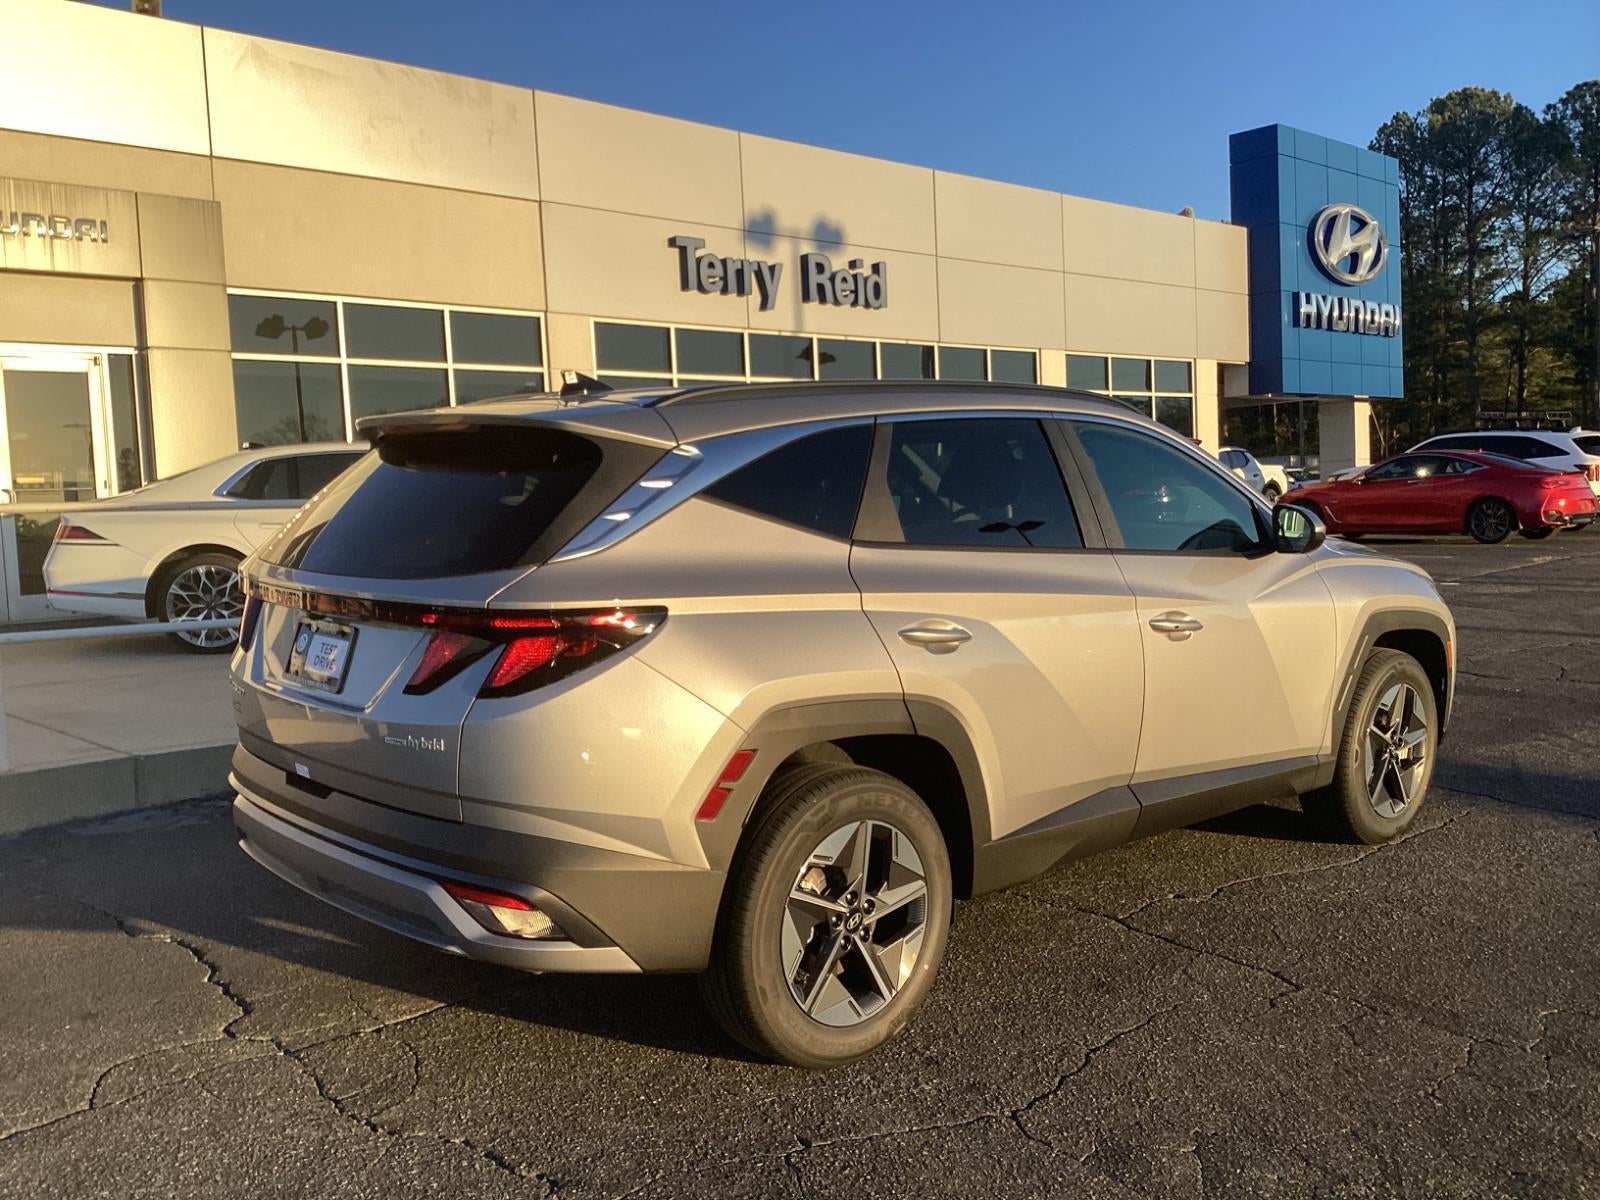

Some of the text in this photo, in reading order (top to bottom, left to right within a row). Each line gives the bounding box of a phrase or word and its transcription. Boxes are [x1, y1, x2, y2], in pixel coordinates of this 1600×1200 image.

[668, 236, 888, 311] Terry Reid
[1297, 291, 1400, 337] HYUNDAI
[320, 642, 339, 656] TEST
[313, 655, 337, 671] DRIVE
[407, 734, 445, 752] hybrid
